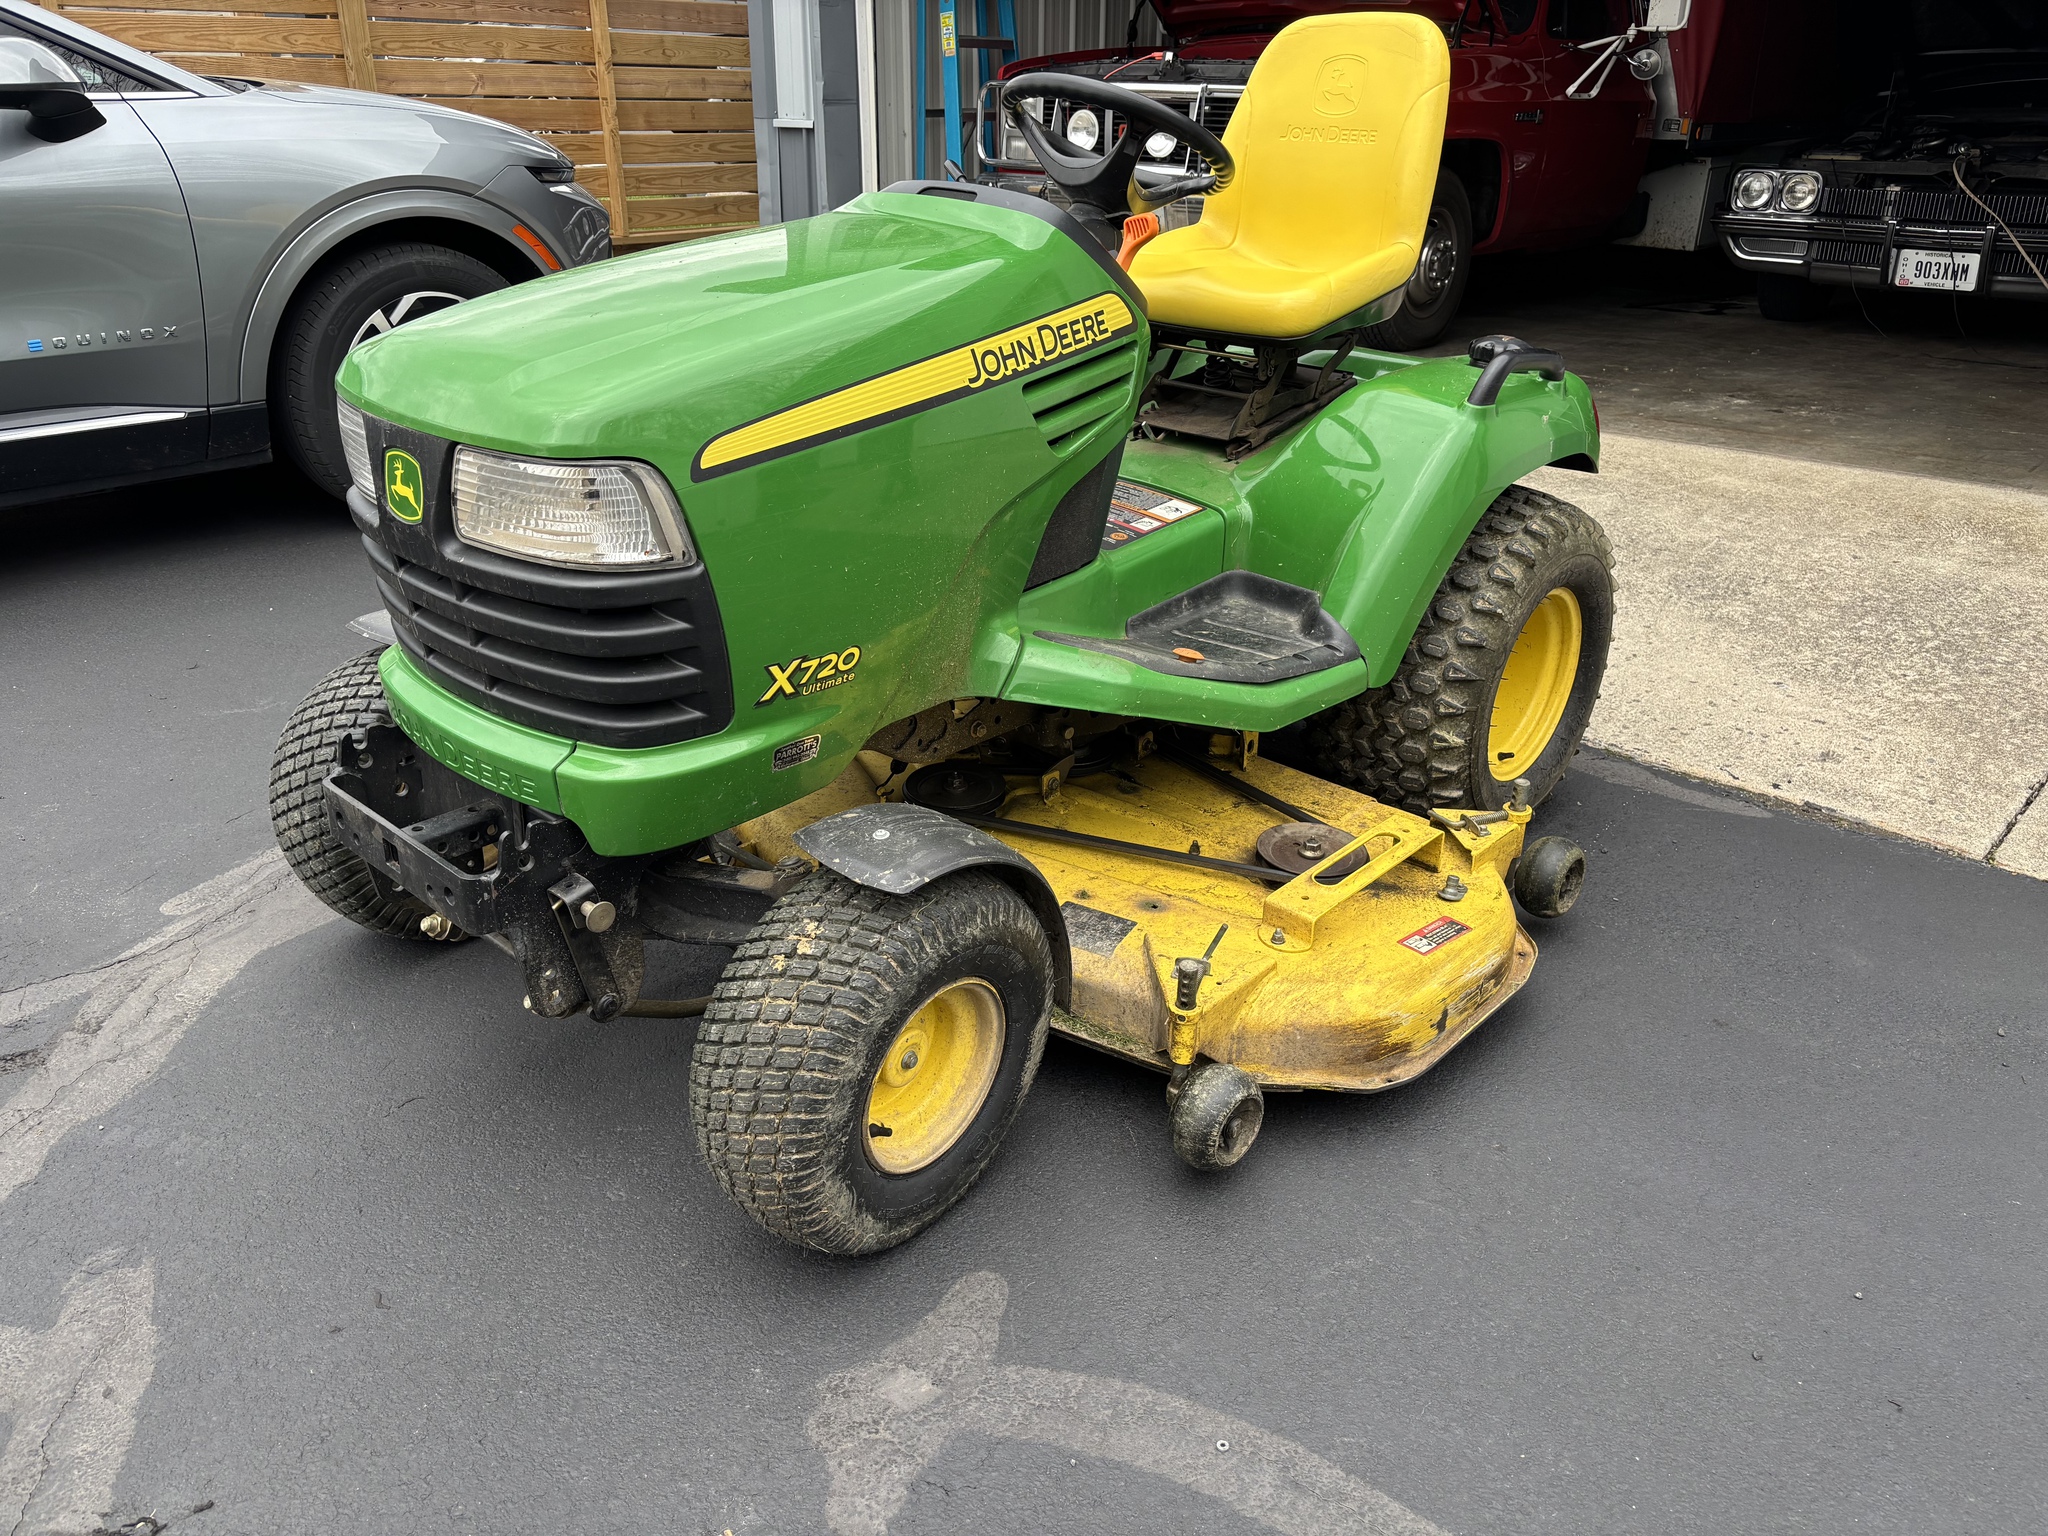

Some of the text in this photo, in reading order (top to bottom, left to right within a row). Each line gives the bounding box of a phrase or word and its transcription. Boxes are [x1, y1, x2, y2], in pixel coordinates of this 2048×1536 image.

[1279, 124, 1378, 145] JOHN DEERE
[1900, 257, 1909, 279] OHIO
[27, 325, 178, 353] EQUINOX
[968, 309, 1110, 386] JOHN DEERE
[758, 645, 861, 702] X720
[802, 672, 855, 696] Ultimate
[776, 740, 817, 761] PARROTT'S
[440, 734, 540, 803] DEERE
